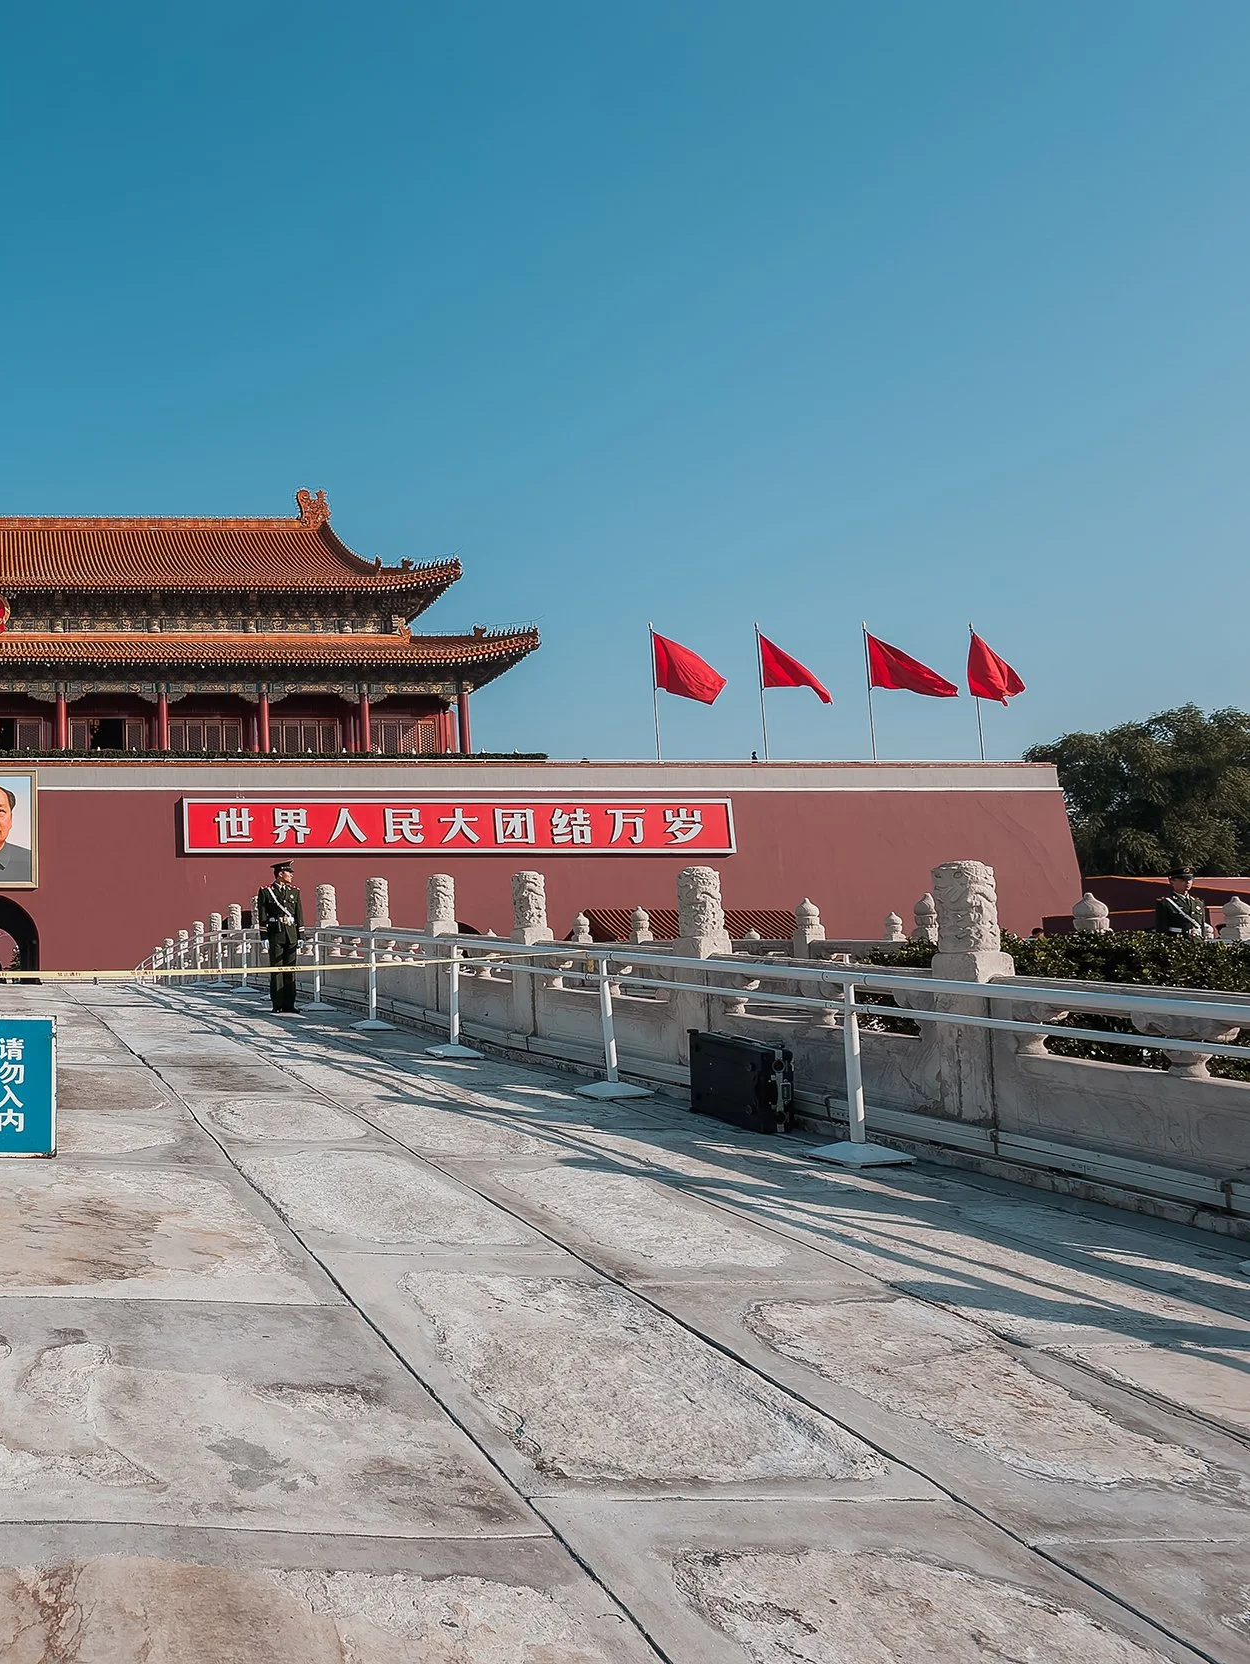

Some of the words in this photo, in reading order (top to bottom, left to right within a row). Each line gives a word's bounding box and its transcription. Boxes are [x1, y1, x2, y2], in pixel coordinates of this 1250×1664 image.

[214, 807, 704, 844] 世界人民大团结万岁
